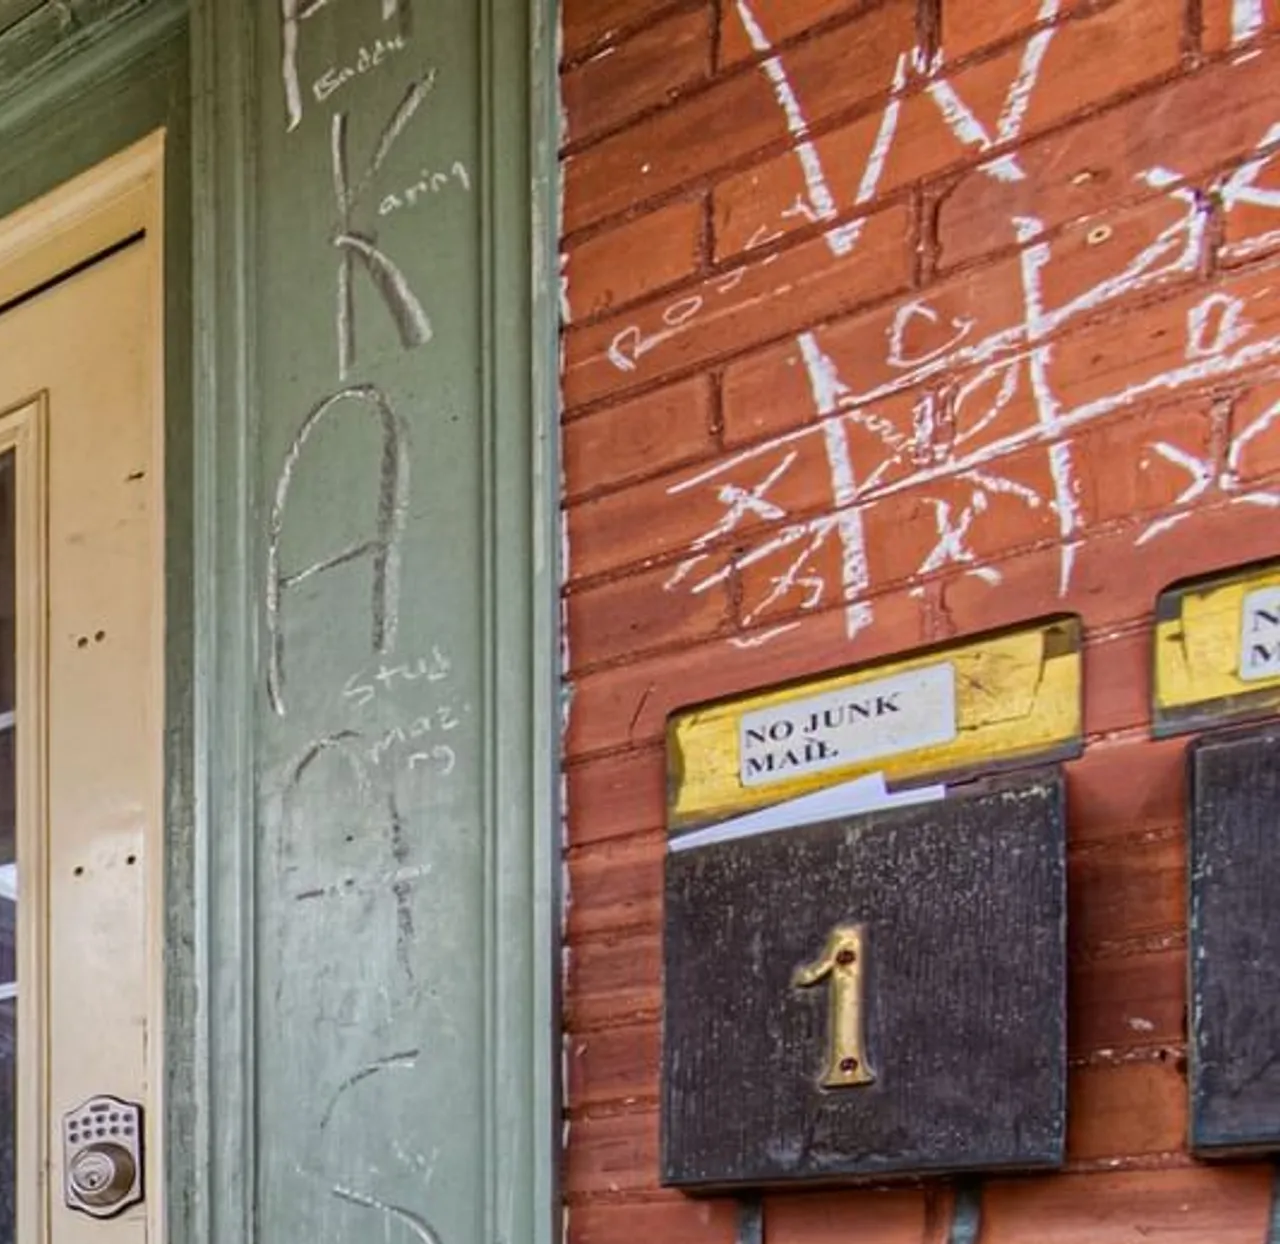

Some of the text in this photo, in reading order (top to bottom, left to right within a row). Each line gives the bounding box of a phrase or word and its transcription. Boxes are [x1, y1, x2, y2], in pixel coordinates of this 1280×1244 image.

[745, 691, 901, 748] NO JUNK
[791, 922, 878, 1090] 1
